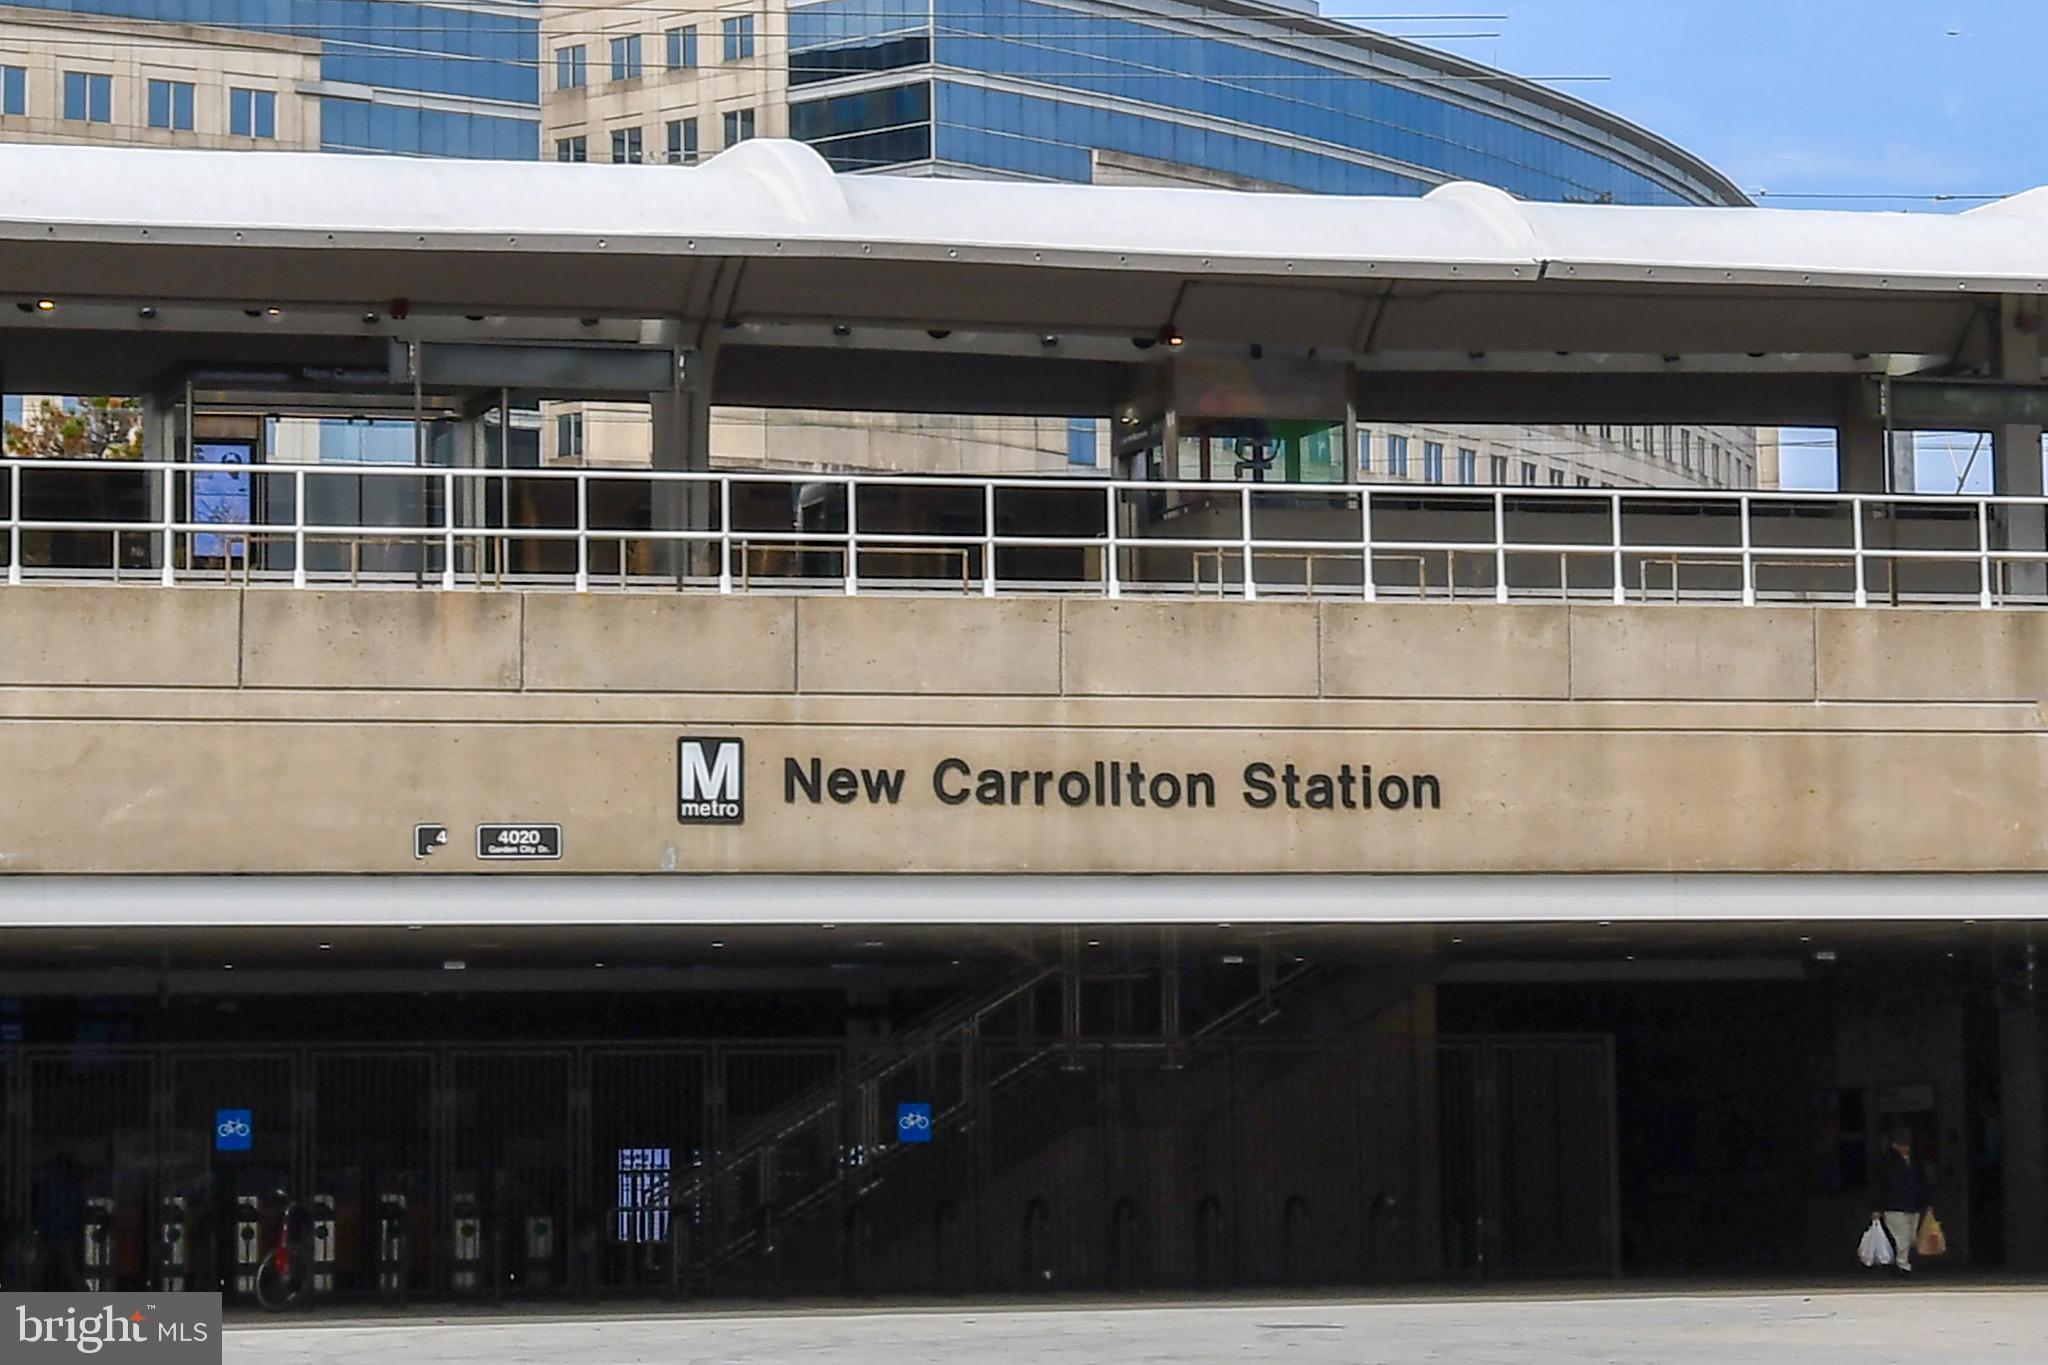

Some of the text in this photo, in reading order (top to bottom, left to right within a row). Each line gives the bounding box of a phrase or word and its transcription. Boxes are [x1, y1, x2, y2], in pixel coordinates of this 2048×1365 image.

[681, 742, 740, 800] M
[785, 758, 1440, 810] New Carrollton Station
[681, 801, 739, 818] metro
[497, 830, 540, 844] 4020
[519, 845, 536, 855] City
